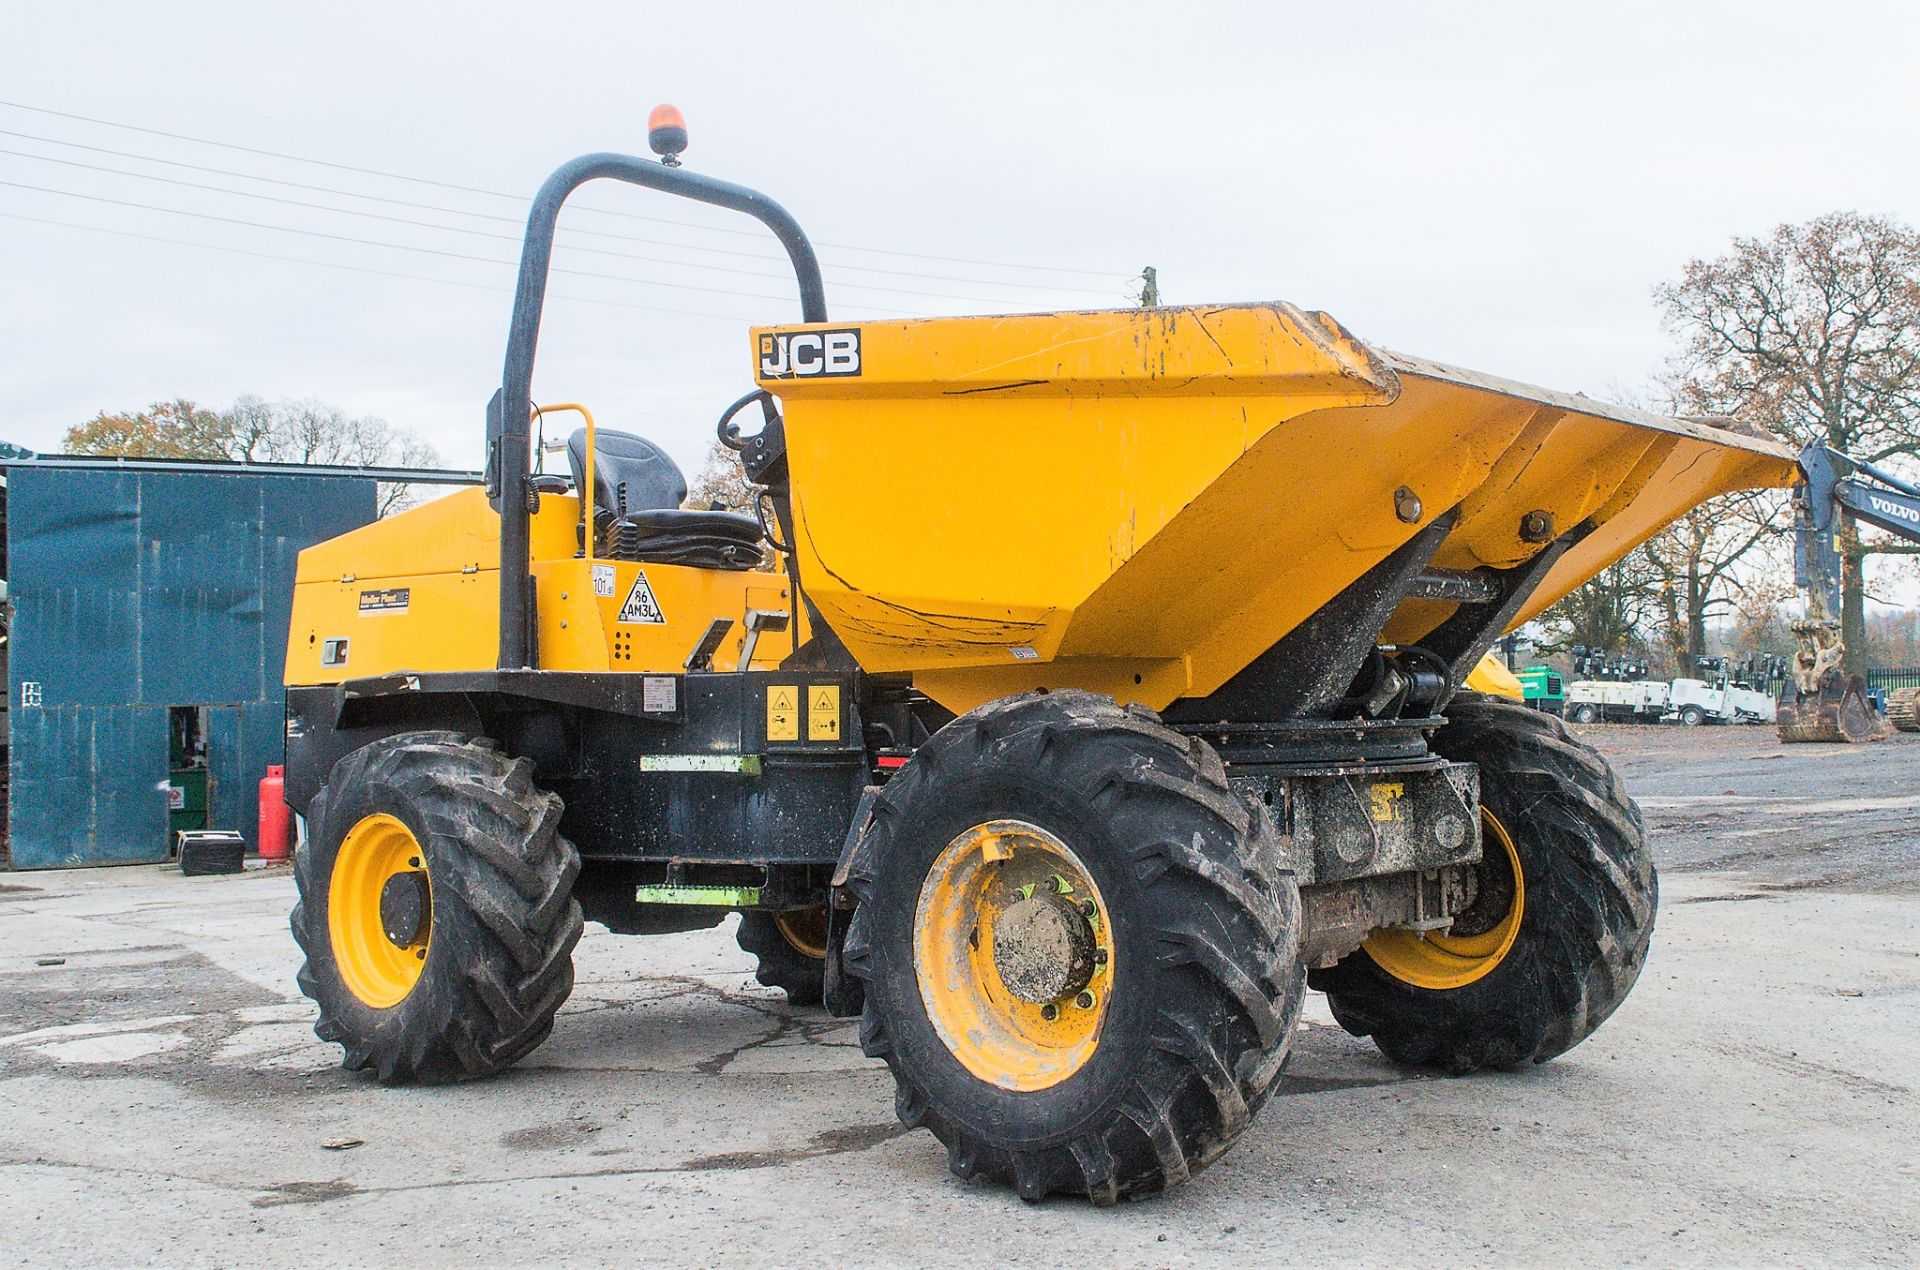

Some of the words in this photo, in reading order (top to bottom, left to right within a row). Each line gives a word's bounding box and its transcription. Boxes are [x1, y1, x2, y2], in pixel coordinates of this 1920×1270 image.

[761, 332, 860, 376] JCB
[1869, 496, 1920, 522] VOLVO
[594, 577, 606, 593] 101
[627, 603, 656, 617] AM3L
